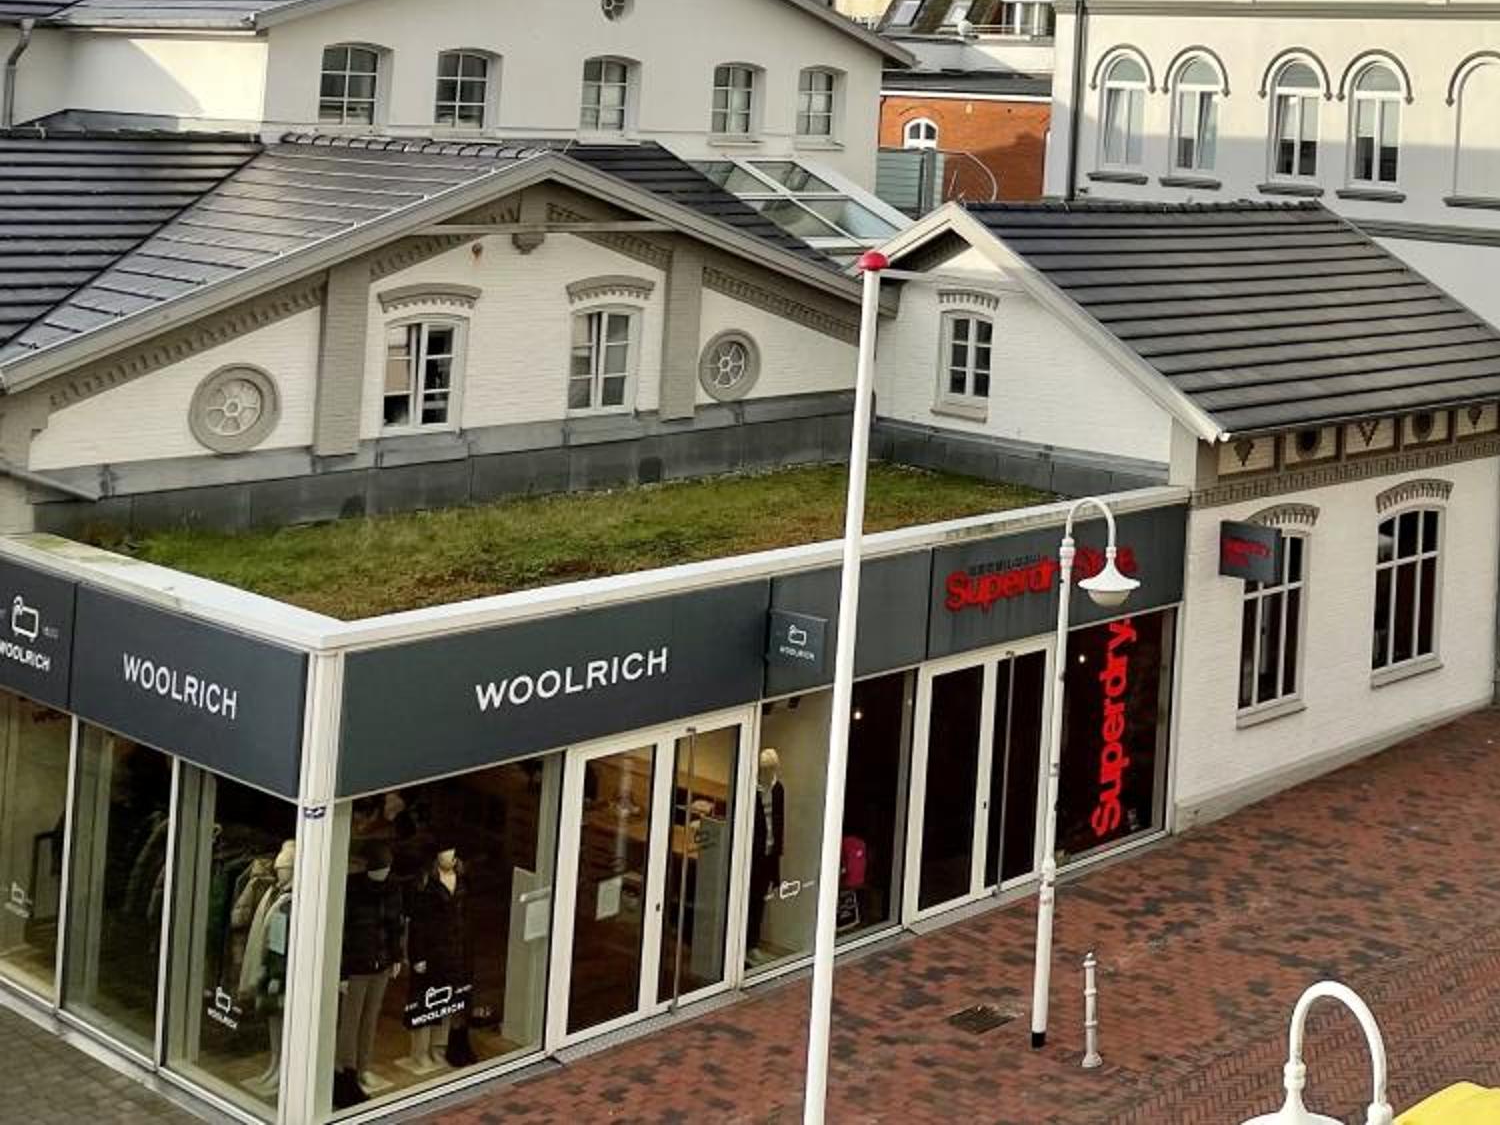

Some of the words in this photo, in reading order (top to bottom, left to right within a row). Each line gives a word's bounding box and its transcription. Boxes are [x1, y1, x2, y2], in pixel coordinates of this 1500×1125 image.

[123, 652, 238, 719] WOOLRICH
[475, 647, 668, 712] WOOLRICH
[411, 1000, 466, 1026] WOOLRICH
